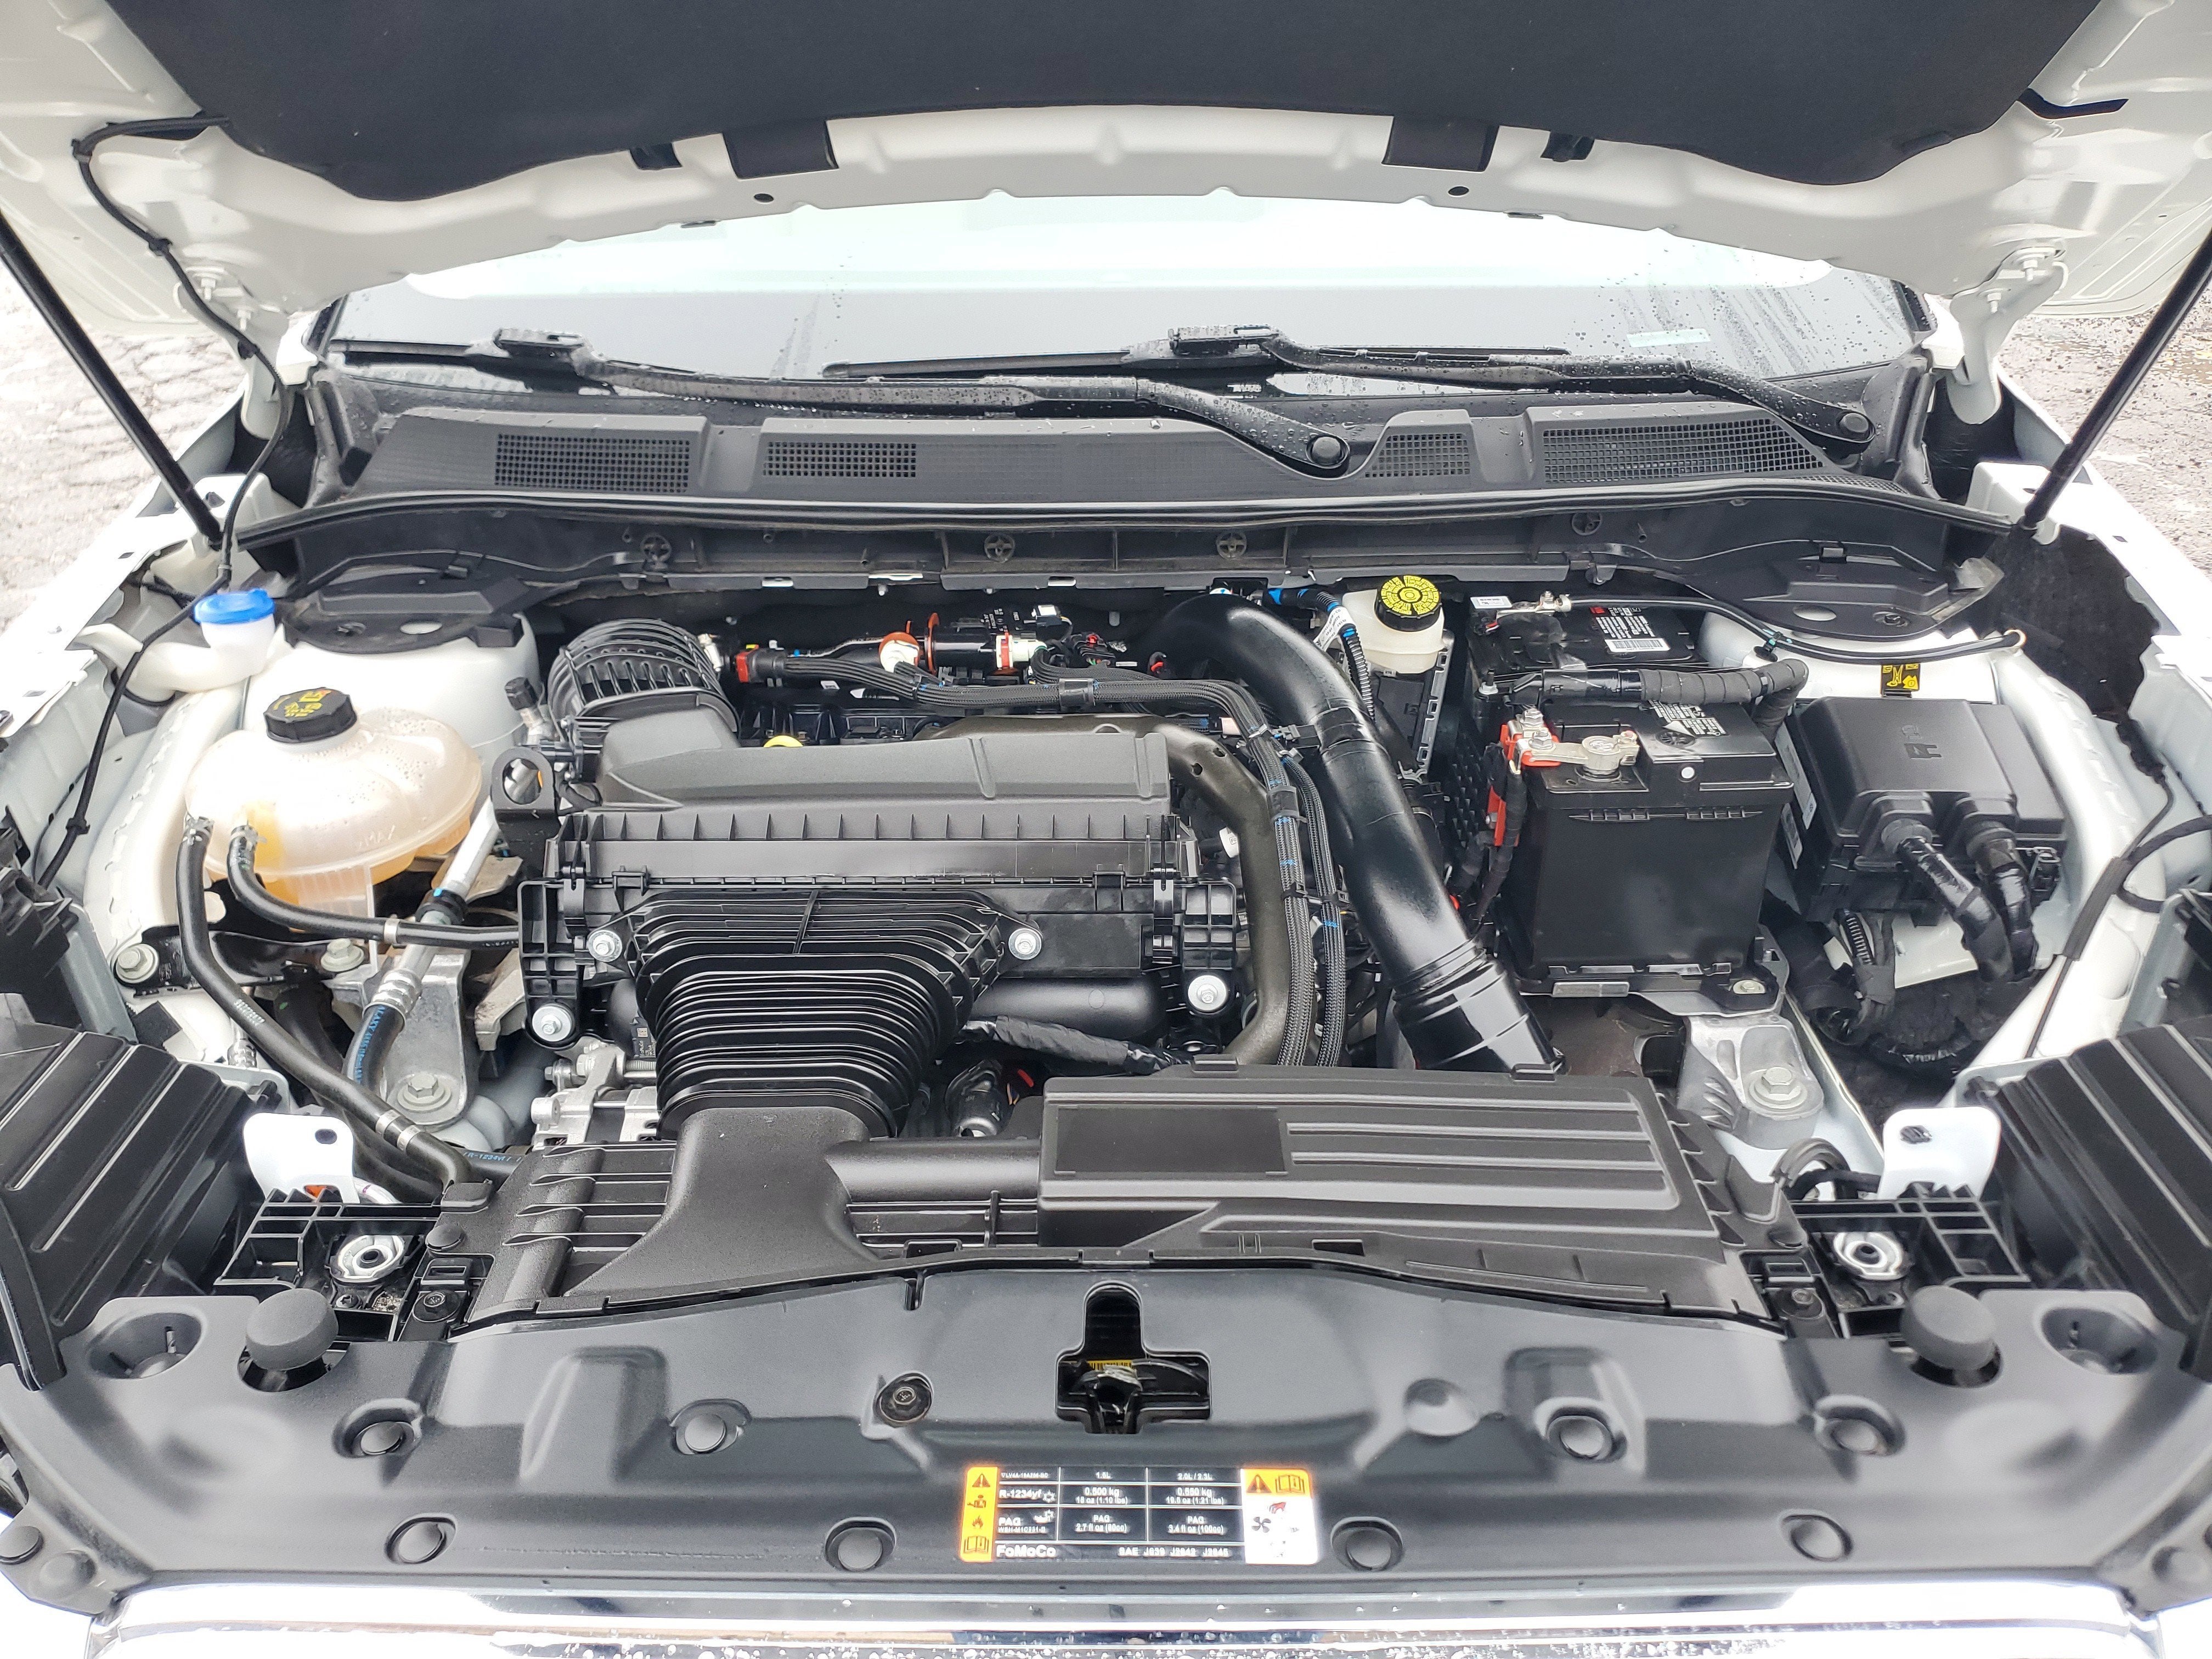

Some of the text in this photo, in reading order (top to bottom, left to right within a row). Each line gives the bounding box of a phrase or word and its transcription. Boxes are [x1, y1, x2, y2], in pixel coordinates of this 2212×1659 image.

[999, 1489, 1042, 1500] R-1234yf
[1085, 1487, 1120, 1498] 0.500 kg
[1201, 1487, 1212, 1498] kg
[998, 1517, 1021, 1526] PAG
[1187, 1516, 1204, 1524] PAG
[1076, 1523, 1087, 1532] 2.7
[996, 1544, 1057, 1558] FoMoCo
[1119, 1547, 1138, 1556] SAE
